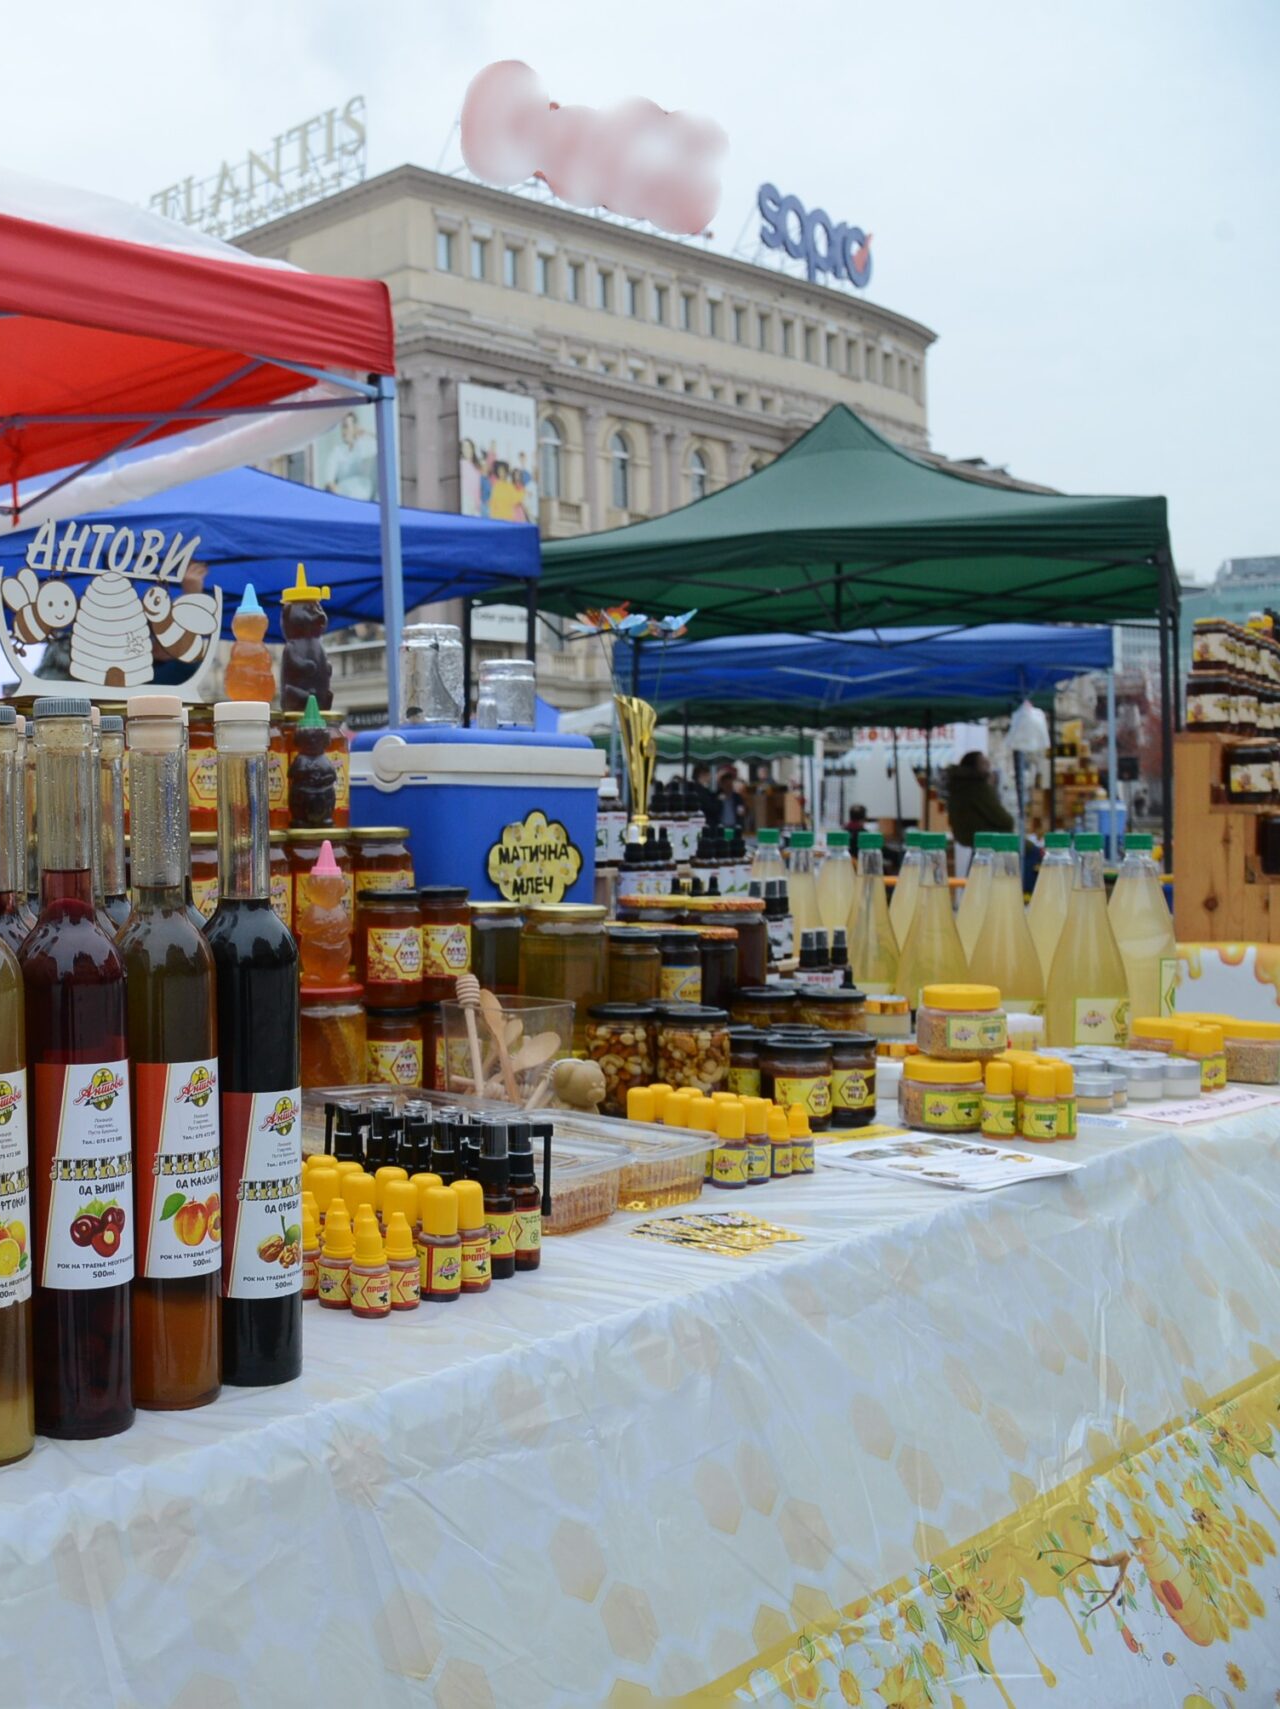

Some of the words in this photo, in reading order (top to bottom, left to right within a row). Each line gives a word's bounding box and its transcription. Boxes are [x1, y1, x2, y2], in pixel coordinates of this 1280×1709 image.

[150, 95, 367, 226] TLANTIS
[26, 518, 201, 583] АНТОВИ
[498, 843, 569, 864] МАТИЧНА
[512, 876, 554, 896] МЛЕЧ
[78, 1185, 93, 1195] ОД
[95, 1181, 125, 1195] ВИШНИ
[176, 1179, 189, 1189] ОД
[264, 1204, 277, 1214] ОД
